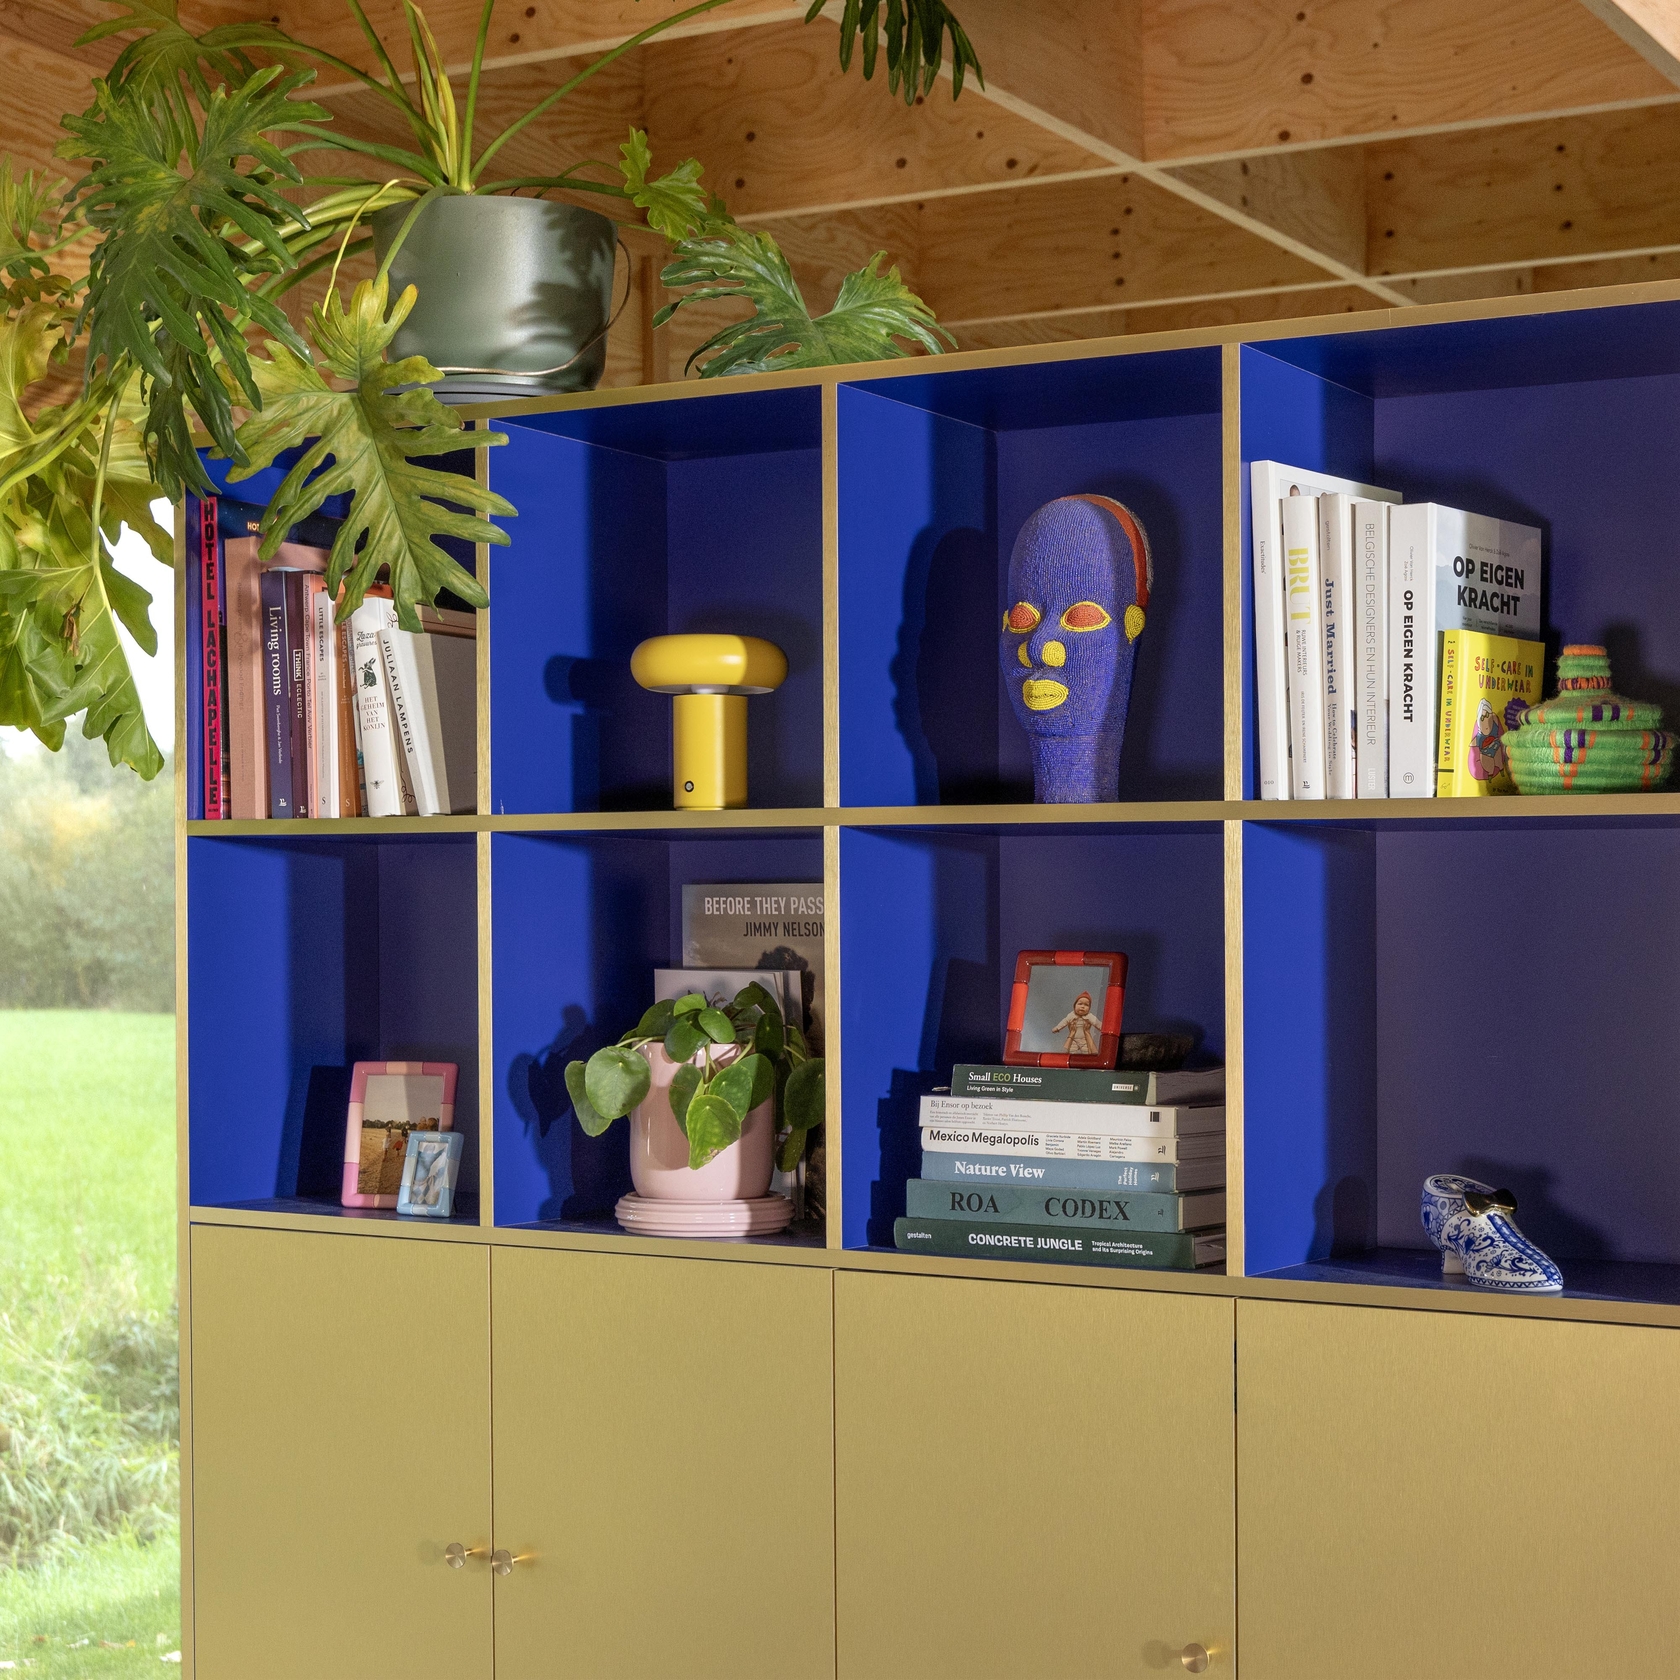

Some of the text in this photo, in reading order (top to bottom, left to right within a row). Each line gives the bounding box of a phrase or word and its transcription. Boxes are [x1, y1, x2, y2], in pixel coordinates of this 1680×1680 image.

[203, 501, 215, 601] HOTEL
[1453, 555, 1525, 590] OP EIGEN
[1288, 547, 1311, 625] BRUT
[1457, 584, 1521, 617] KRACHT
[1325, 578, 1337, 695] Just Married
[1365, 523, 1377, 746] BELGISCHE DESIGNERS EN HUN INTERIEUR
[267, 606, 283, 696] Living rooms
[1403, 590, 1414, 723] OP EIGEN KRACHT
[1525, 664, 1534, 678] IN
[1478, 674, 1532, 694] UNDERWEAR
[382, 639, 400, 692] JULIAAN
[396, 696, 414, 754] LAMPENS
[1445, 698, 1452, 707] IN
[206, 609, 218, 805] LACHAPELLE
[366, 716, 379, 724] HET
[1443, 710, 1452, 763] UNDERWEAR
[1328, 751, 1333, 759] in
[1367, 767, 1376, 791] LUSTER
[704, 896, 824, 915] BEFORE THEY PASS
[743, 921, 825, 937] JIMMY NELSON
[968, 1071, 1043, 1084] Small ECO Houses
[930, 1100, 940, 1109] Bij
[941, 1100, 960, 1108] Ensor
[971, 1101, 993, 1110] bezoek
[929, 1129, 1039, 1148] Mexico Megalopolis
[954, 1161, 1045, 1179] Nature View
[949, 1191, 1131, 1221] ROA CODEX
[906, 1231, 932, 1239] gestalten
[968, 1233, 1083, 1251] CONCRETE JUNGLE
[1091, 1240, 1143, 1249] Tropical Architecture
[1109, 1247, 1135, 1255] Surprising
